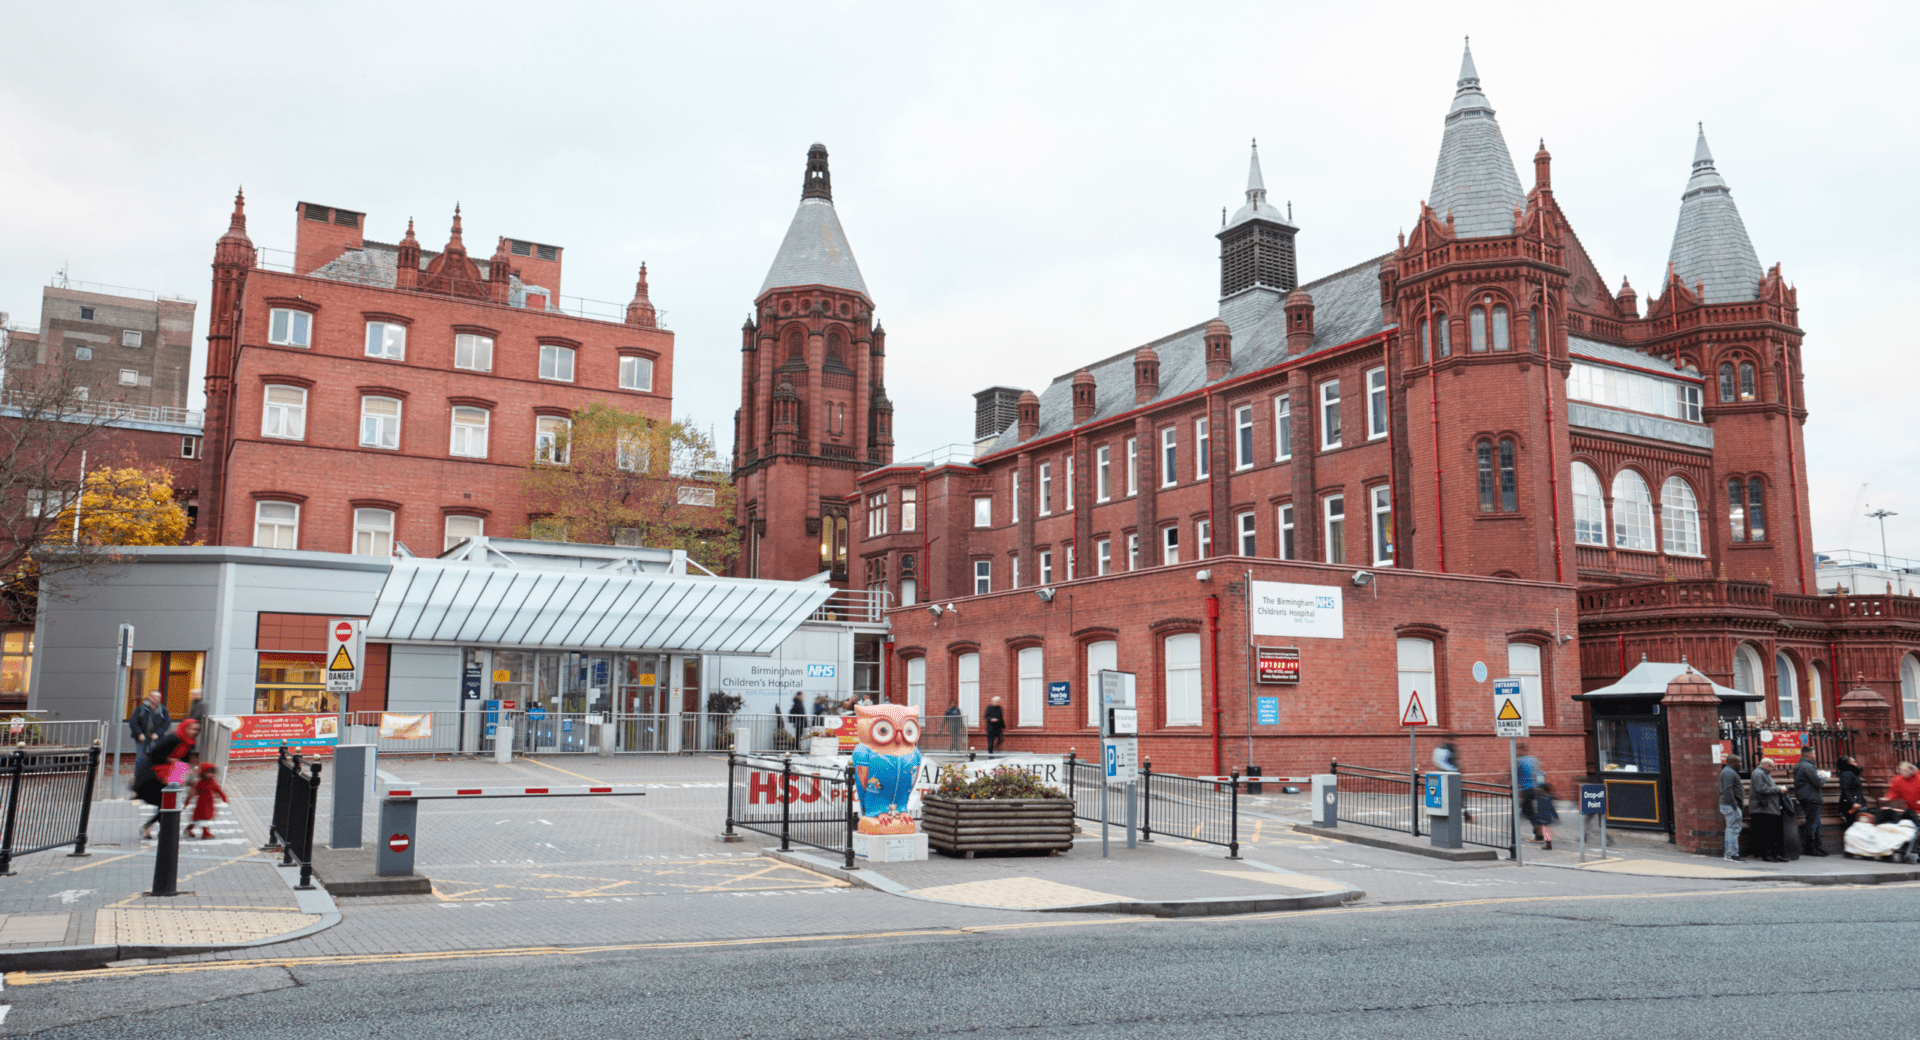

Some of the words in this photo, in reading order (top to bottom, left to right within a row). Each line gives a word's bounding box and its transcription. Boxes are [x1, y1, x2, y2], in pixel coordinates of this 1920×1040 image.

[1277, 597, 1315, 608] Birmingham
[1316, 596, 1335, 609] NHS
[1289, 609, 1315, 618] Hospital
[329, 672, 354, 680] DANGER
[751, 666, 803, 677] Birmingham
[808, 665, 834, 677] NHS
[723, 677, 766, 687] Children's
[768, 679, 803, 689] Hospital
[749, 771, 822, 804] HSJ
[1584, 791, 1604, 800] Drop-off
